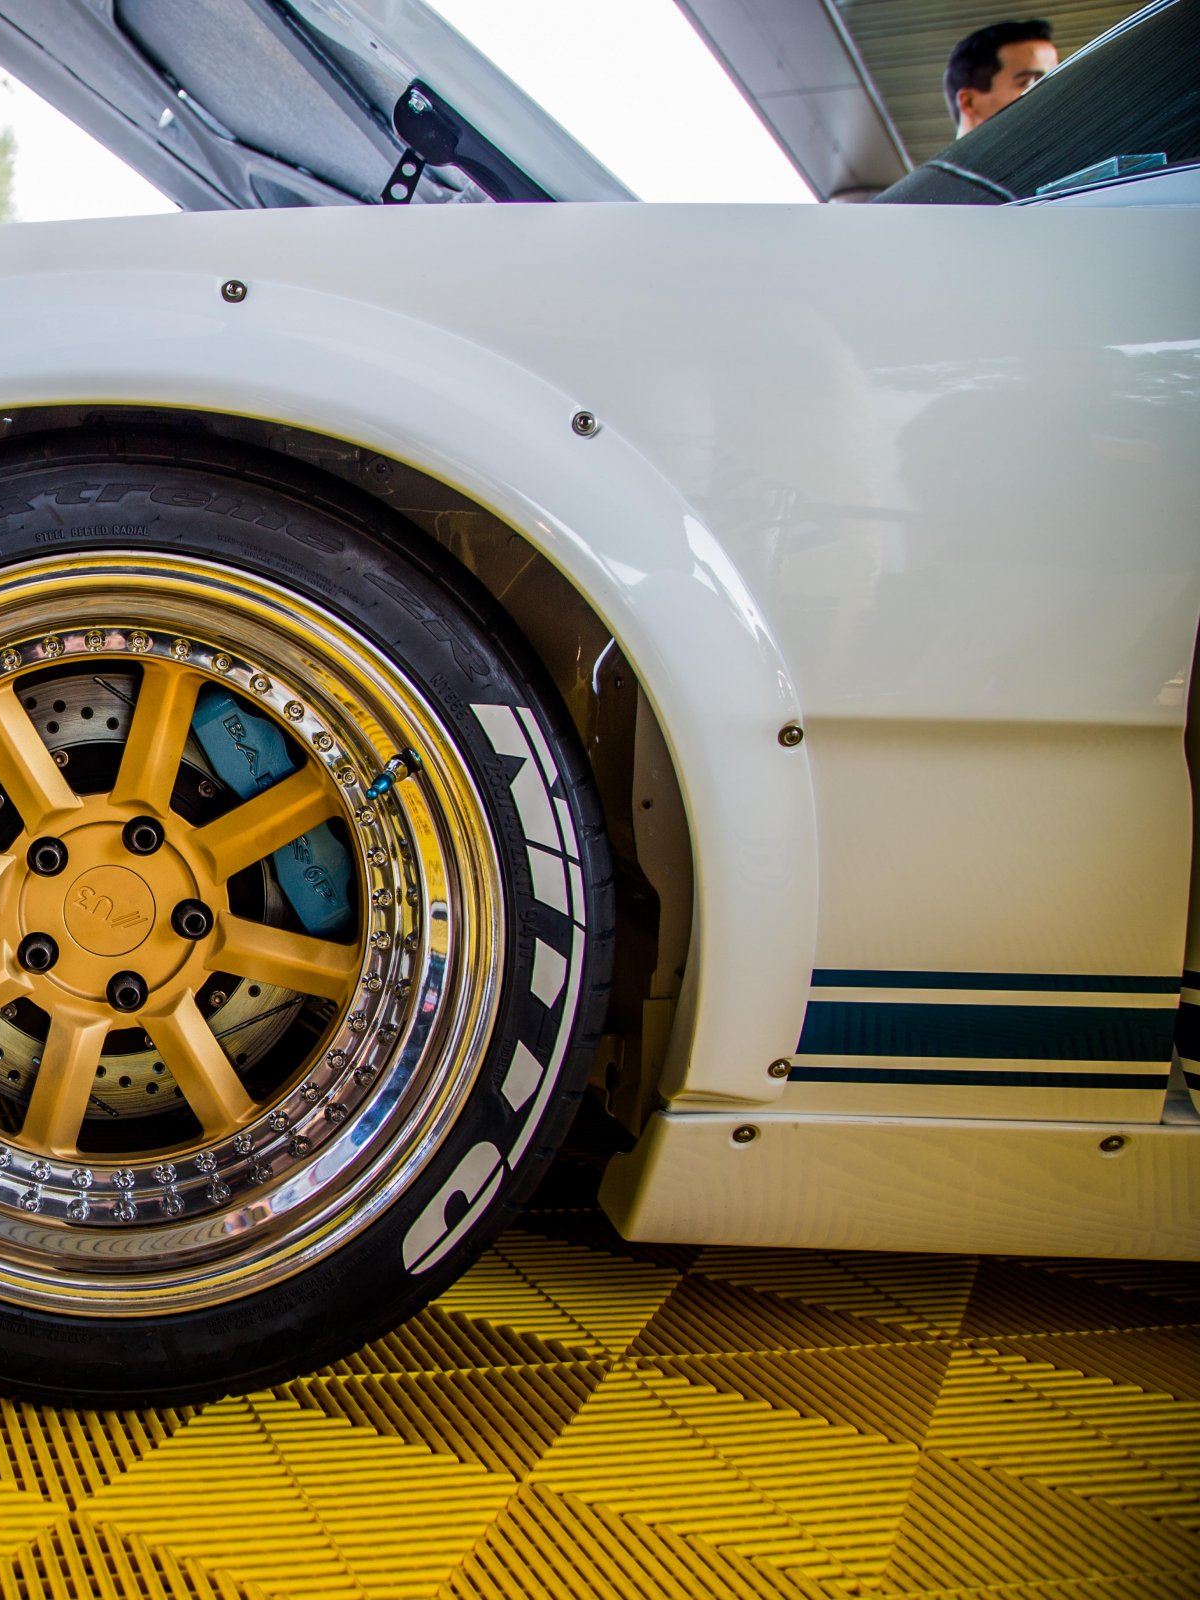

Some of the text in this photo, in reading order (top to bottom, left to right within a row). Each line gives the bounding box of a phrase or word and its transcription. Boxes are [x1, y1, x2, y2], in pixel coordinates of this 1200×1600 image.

[34, 524, 149, 543] STEEL BELTED RADIAL
[223, 713, 277, 790] BA
